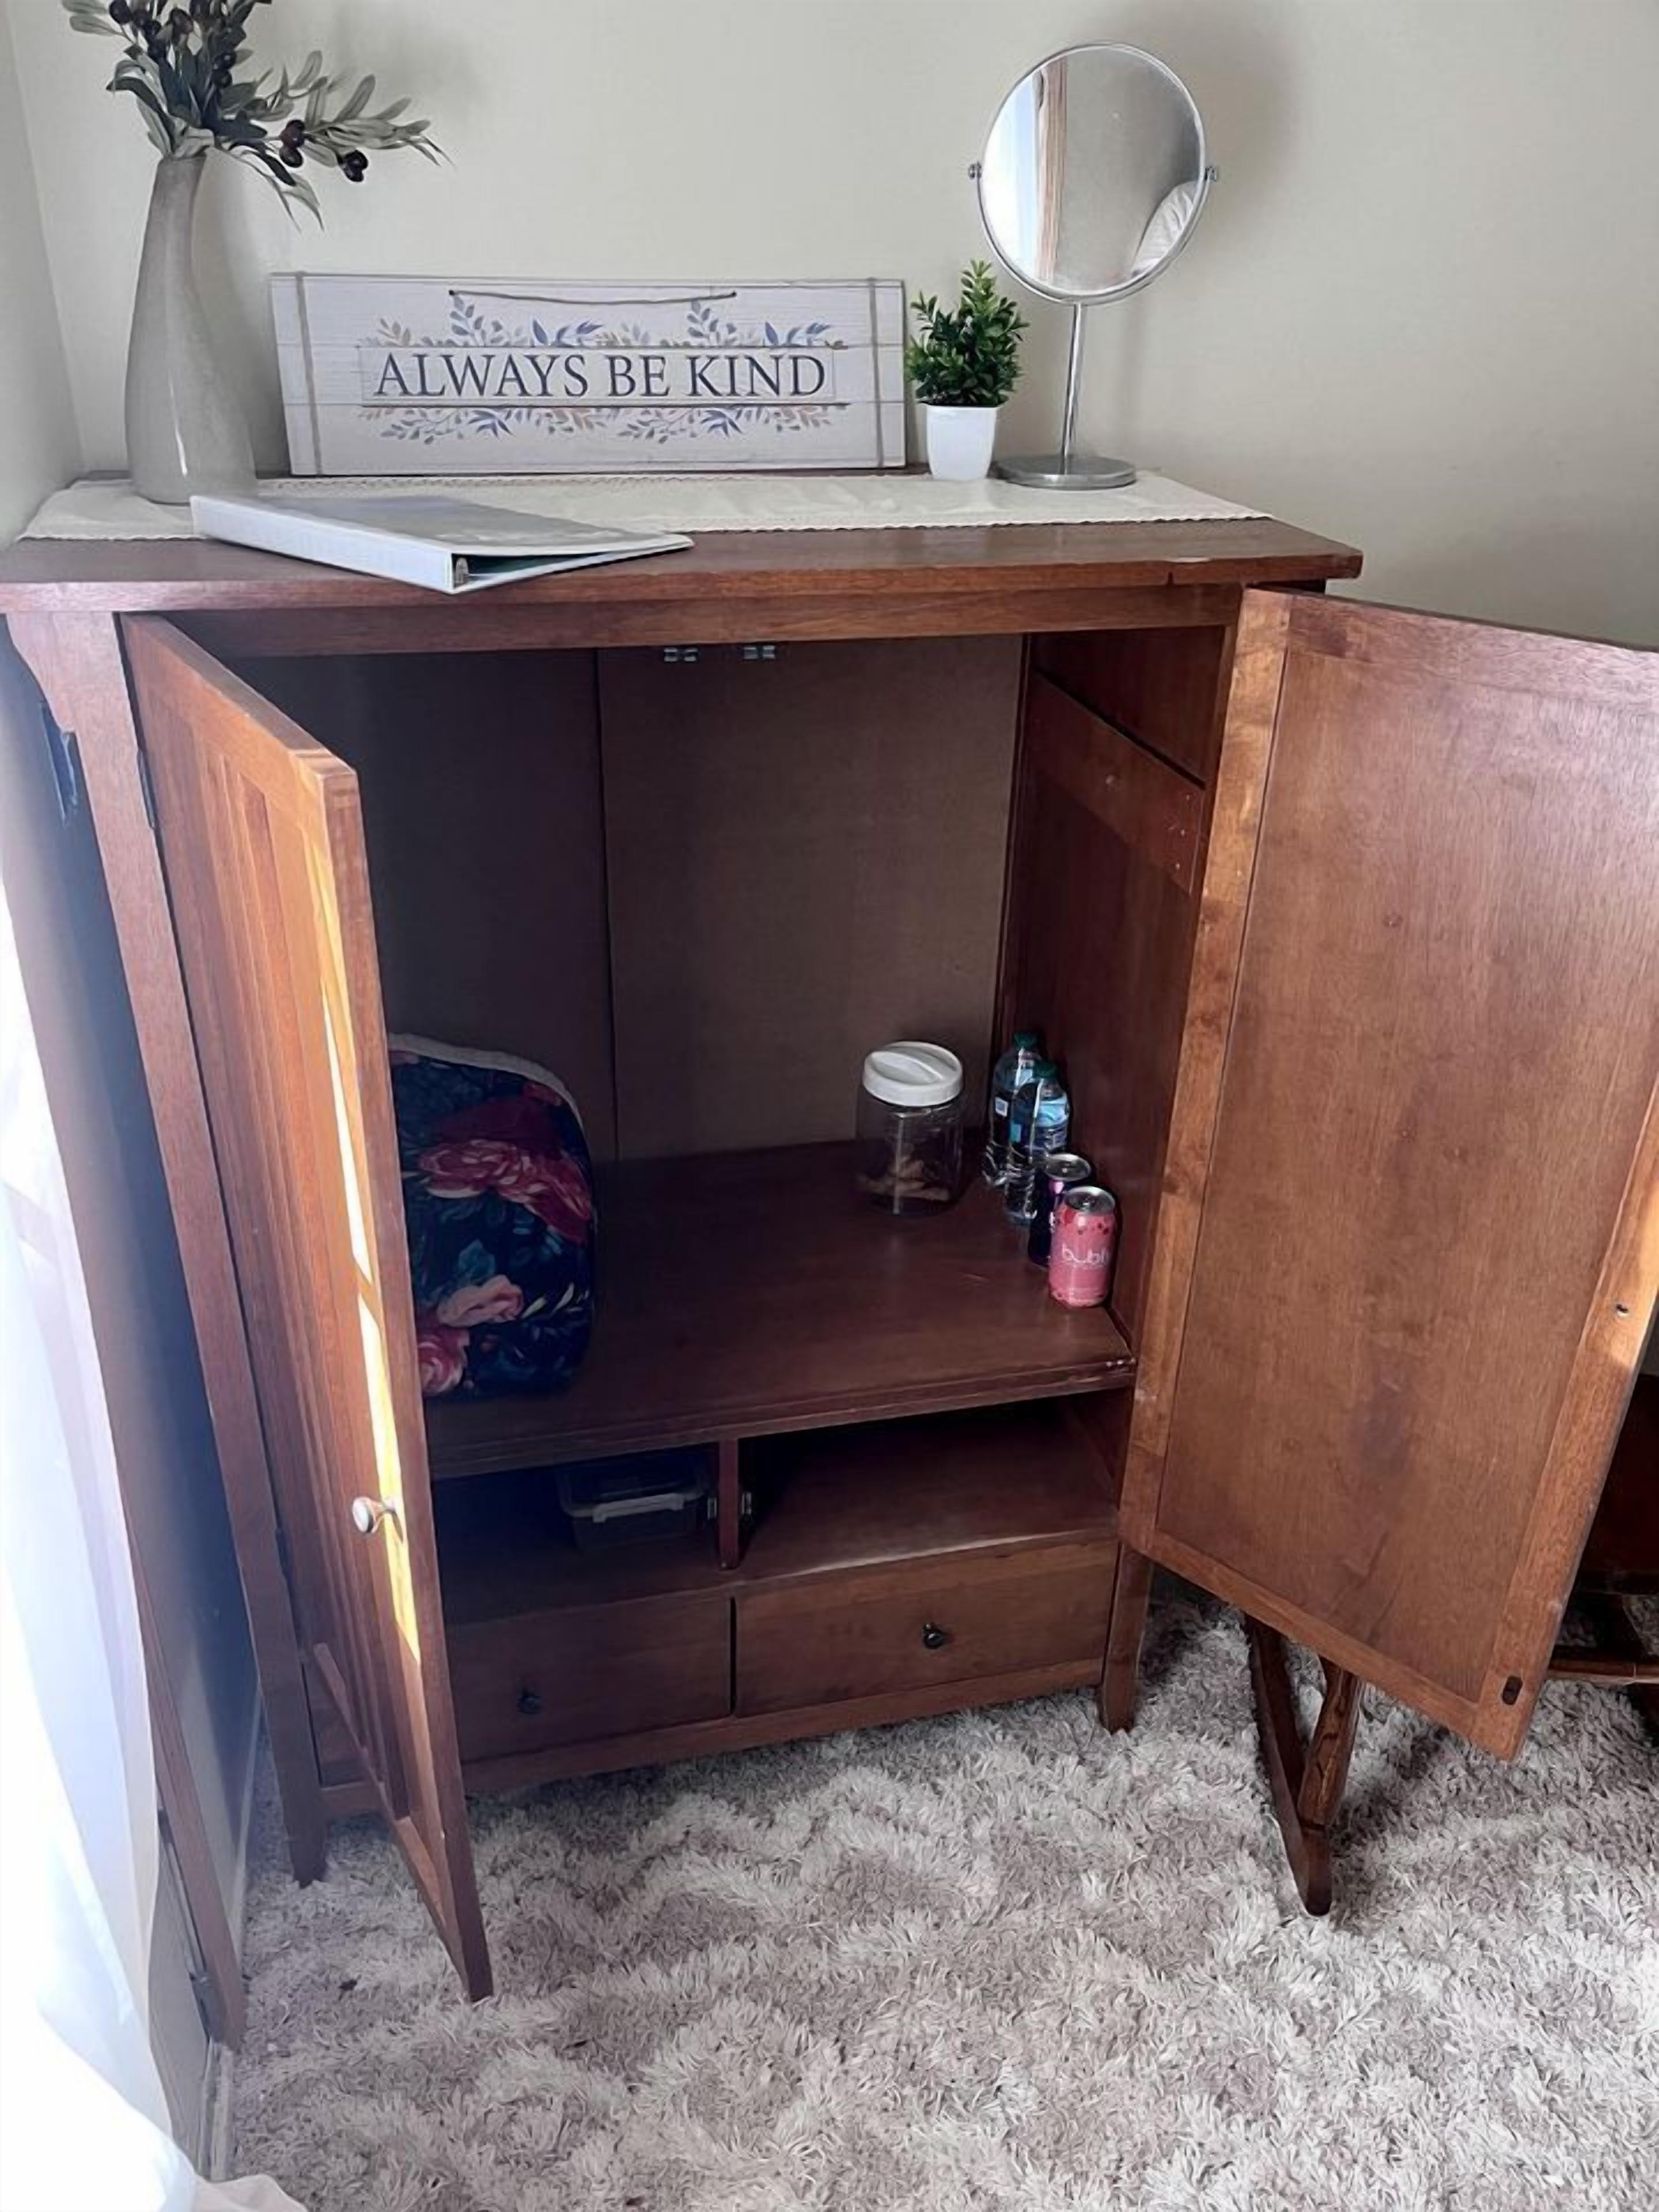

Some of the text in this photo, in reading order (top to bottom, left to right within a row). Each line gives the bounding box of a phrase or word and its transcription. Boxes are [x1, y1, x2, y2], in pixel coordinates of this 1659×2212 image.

[374, 353, 825, 397] ALWAYS BE KIND
